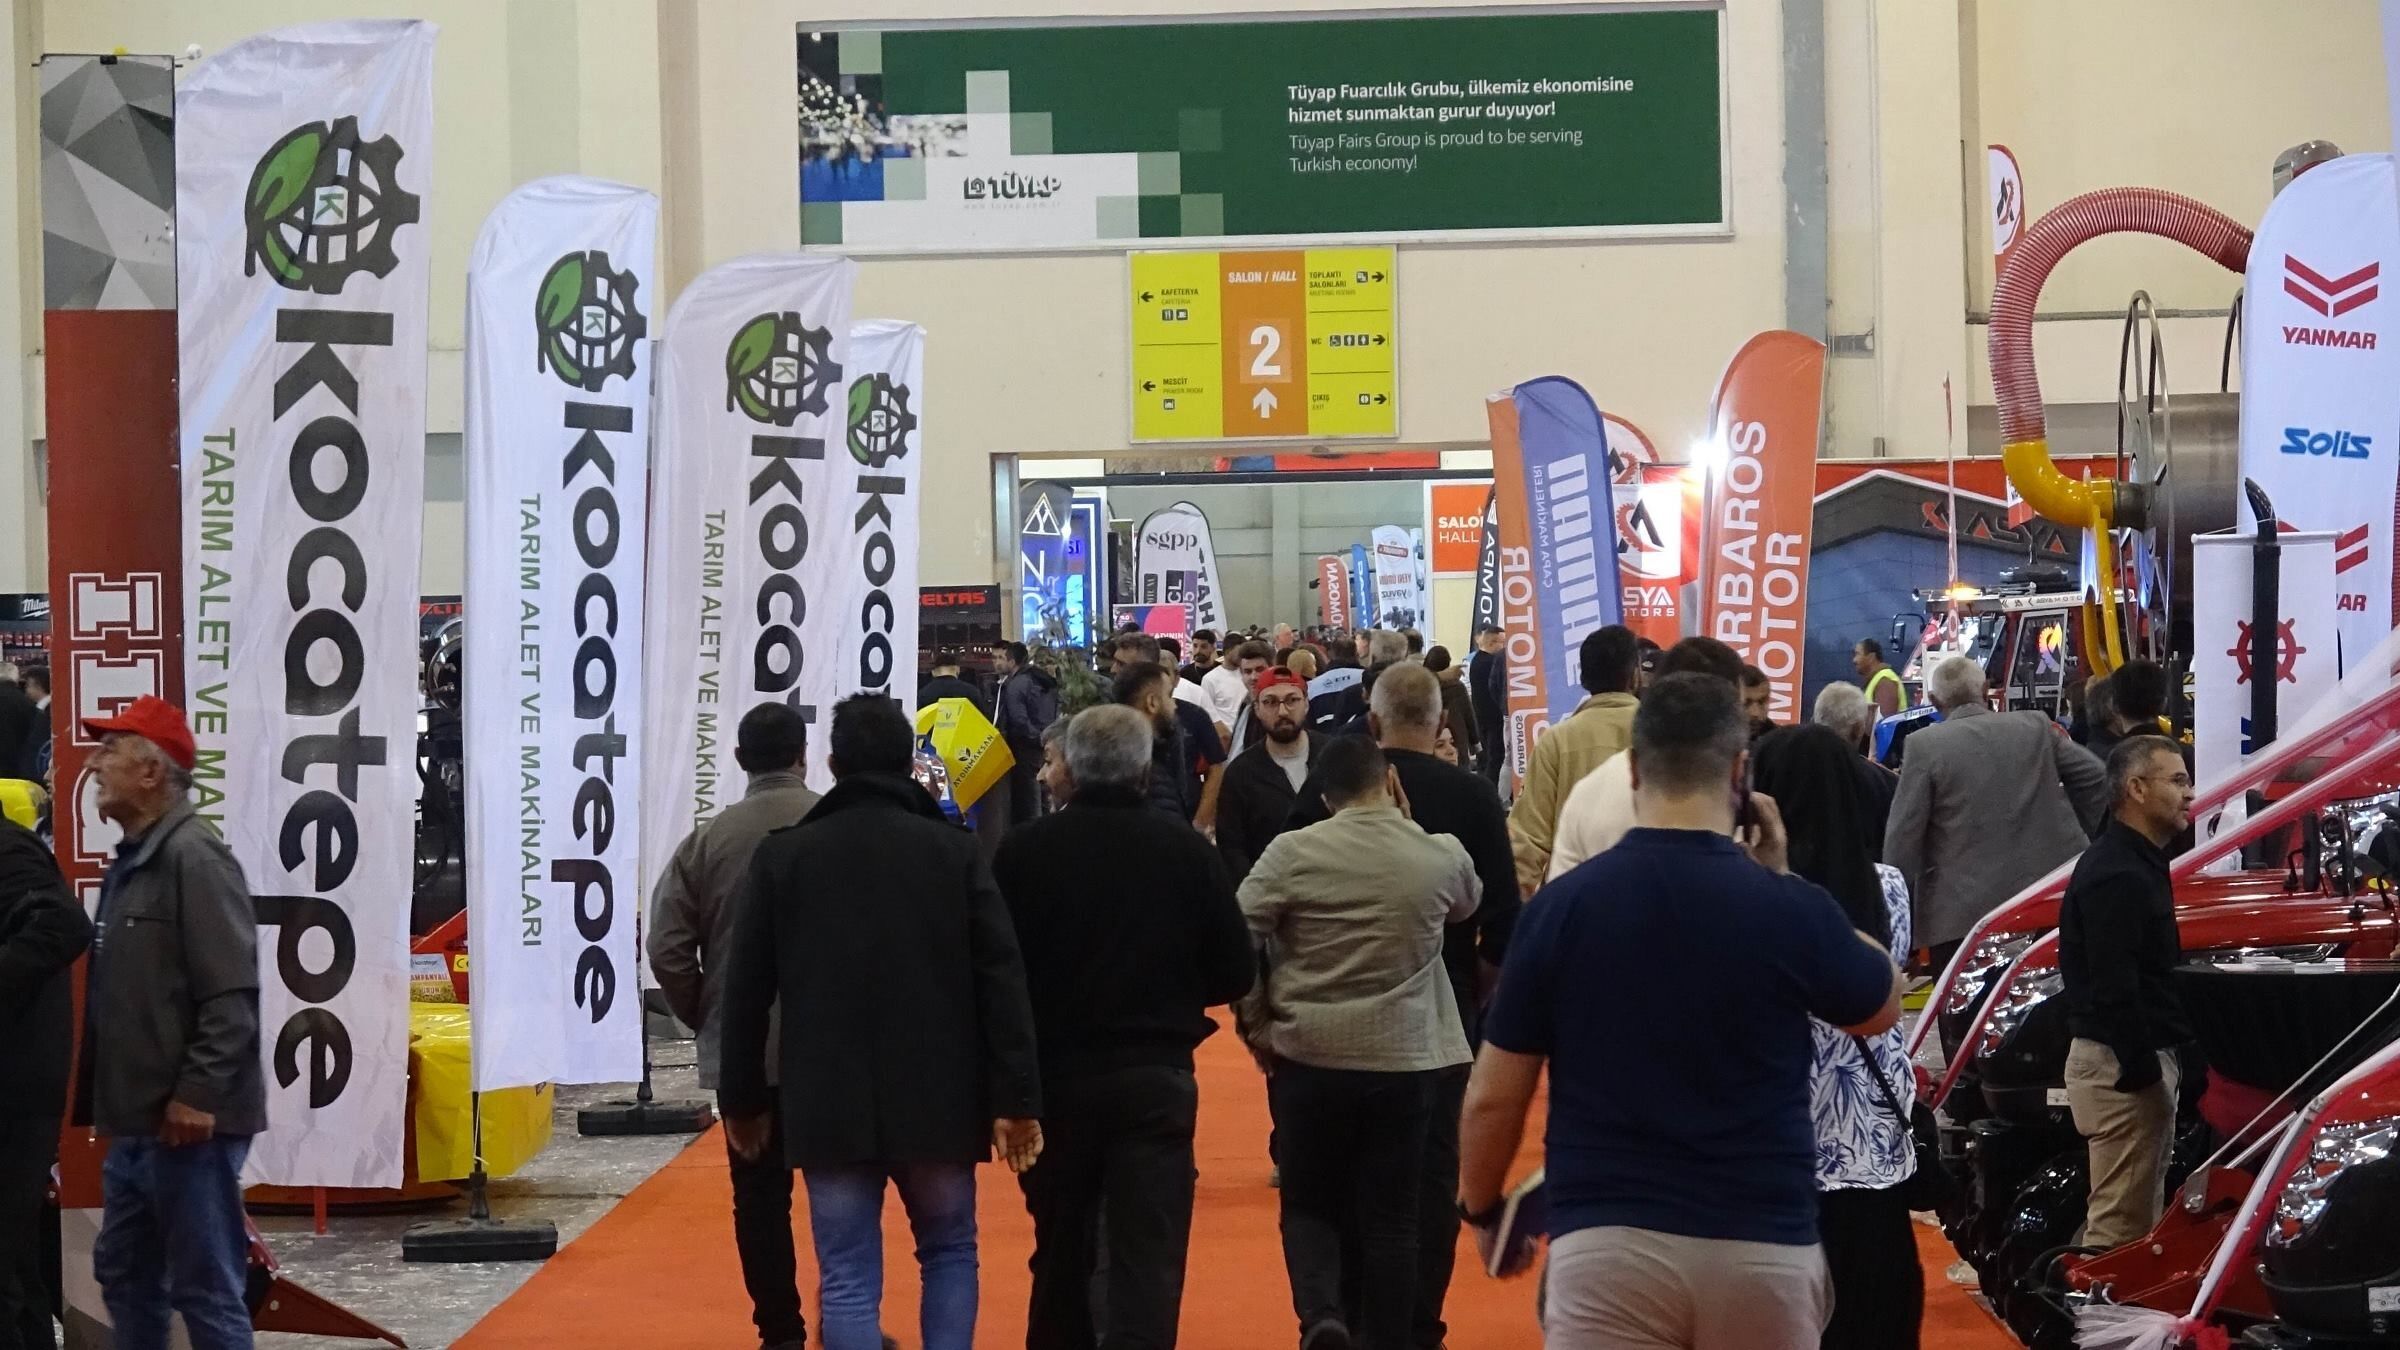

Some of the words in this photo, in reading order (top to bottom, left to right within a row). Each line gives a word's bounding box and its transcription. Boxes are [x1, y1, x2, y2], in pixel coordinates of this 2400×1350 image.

[1288, 85, 1336, 103] Tüyap
[1340, 82, 1406, 98] Fuarcılık
[1411, 80, 1464, 98] Grubu,
[1468, 79, 1530, 95] ülkemiz
[1533, 76, 1634, 93] ekonomisine
[1288, 107, 1343, 123] hizmet
[1346, 104, 1435, 121] sunmaktan
[1438, 105, 1483, 122] gurur
[1486, 101, 1556, 120] duyuyor!
[1288, 134, 1335, 152] Tüyap
[1338, 133, 1372, 148] Fairs
[1375, 132, 1421, 149] Group
[1425, 131, 1436, 145] is
[1440, 129, 1484, 149] proud
[1488, 130, 1503, 144] to
[1507, 128, 1526, 143] be
[1529, 128, 1583, 146] serving
[1288, 155, 1342, 172] Turkish
[1345, 154, 1418, 173] economy!
[987, 170, 1062, 199] TÜYAP
[1161, 288, 1199, 296] KAFETERYA
[1228, 271, 1262, 283] SALON
[1271, 270, 1297, 282] HALL
[1250, 325, 1281, 377] 2
[2282, 326, 2378, 350] YANMAR
[200, 427, 236, 551] TARIM
[520, 493, 542, 591] TARIM
[702, 509, 726, 588] TARIM
[1146, 531, 1198, 551] sgpp
[1439, 531, 1480, 543] HALL
[1715, 421, 1767, 658] RBAROS
[197, 563, 232, 669] ALET
[855, 475, 906, 708] koca
[2336, 593, 2367, 612] AR
[520, 599, 541, 682] ALET
[699, 595, 722, 662] ALET
[1757, 531, 1803, 721] MOTOR
[194, 681, 229, 735] VE
[250, 308, 395, 1109] kocatepe
[520, 692, 541, 734] VE
[551, 402, 634, 1024] kocatepe
[697, 670, 719, 703] VE
[693, 712, 721, 831] MAKİNAL
[193, 749, 232, 850] MAK
[520, 745, 546, 947] MAKİNALARI
